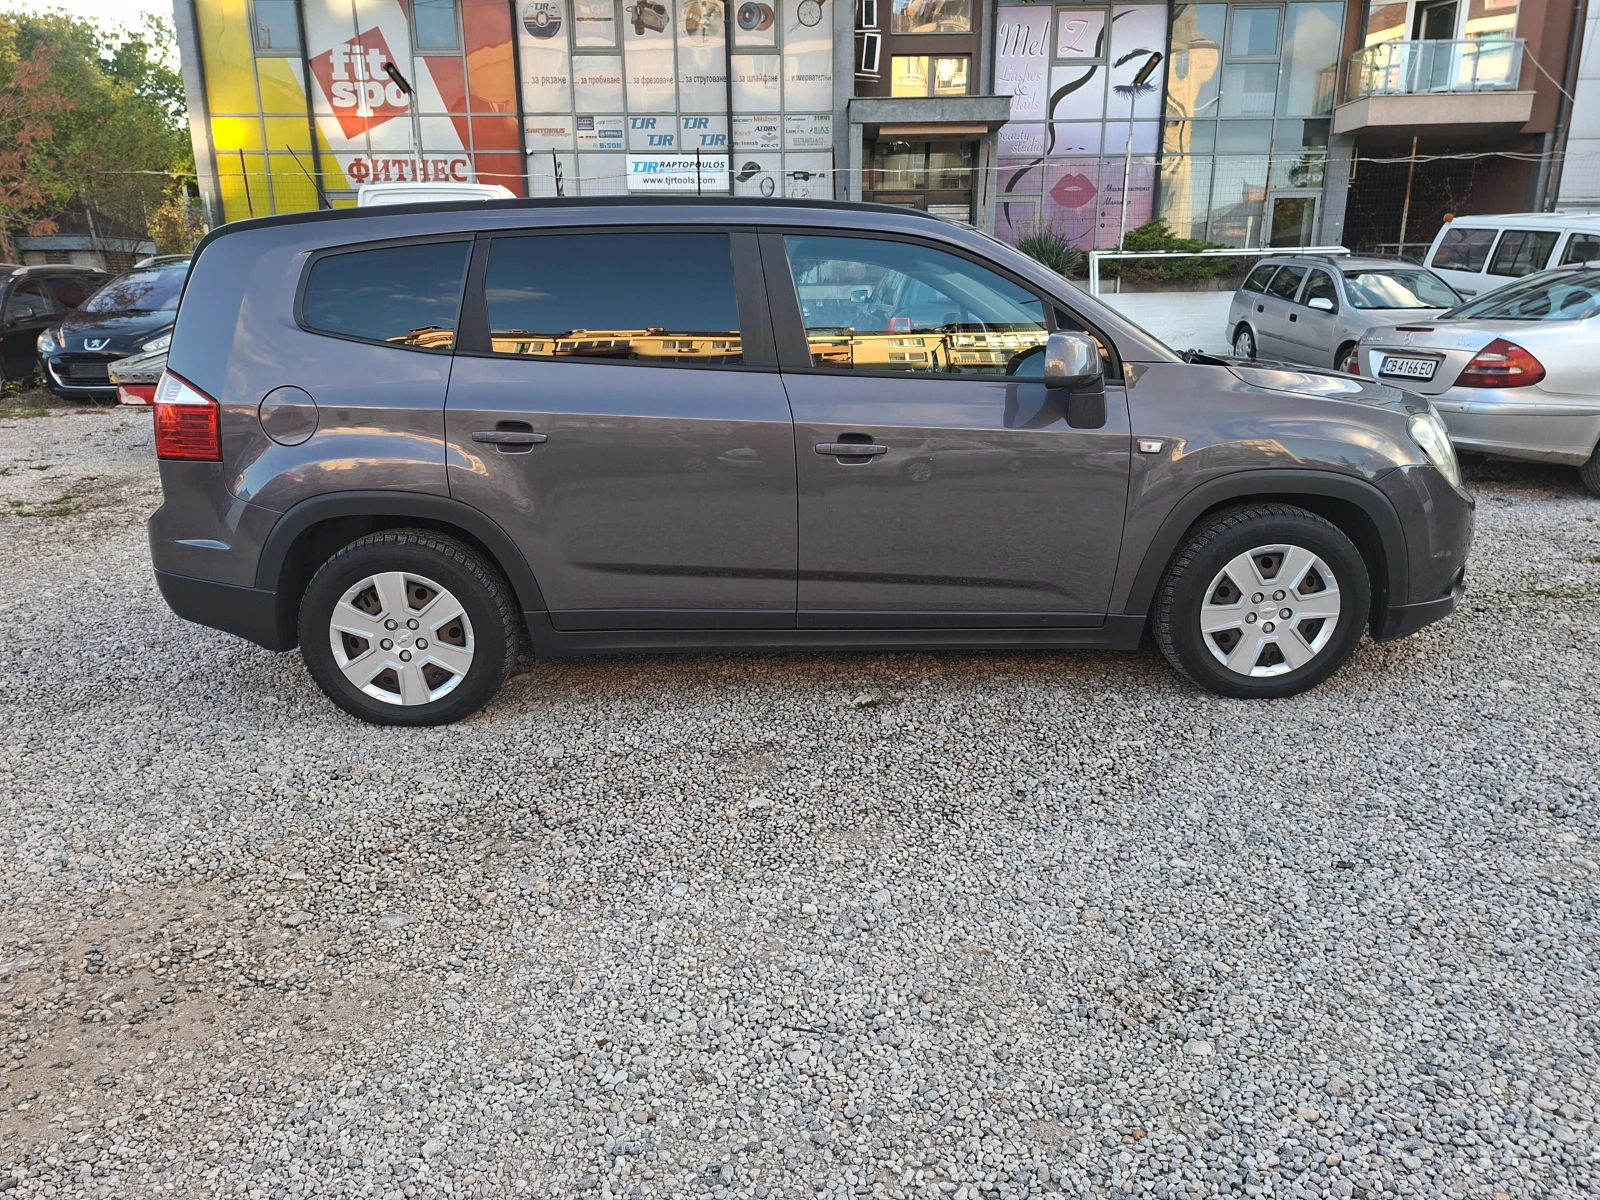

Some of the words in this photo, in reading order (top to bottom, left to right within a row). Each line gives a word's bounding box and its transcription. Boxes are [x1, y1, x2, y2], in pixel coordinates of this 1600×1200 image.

[1000, 21, 1049, 57] Mel
[1060, 19, 1089, 54] Z
[329, 44, 390, 80] fit
[998, 63, 1041, 81] Lashes
[531, 76, 539, 84] за
[541, 76, 567, 86] рязане
[589, 75, 620, 86] пробиване
[641, 75, 674, 86] фрезоване
[694, 76, 727, 85] струговане
[747, 73, 778, 84] шлайфане
[1014, 79, 1029, 96] &
[1010, 92, 1040, 111] Nails
[630, 118, 657, 129] TJR
[682, 118, 709, 129] TJR
[647, 135, 674, 146] TJR
[699, 134, 726, 146] TJR
[1012, 137, 1043, 153] studio
[347, 157, 469, 184] ФИТНЕС
[632, 161, 659, 173] TJR
[660, 161, 725, 169] RAPTOPOULOS
[1397, 360, 1420, 374] 4166
